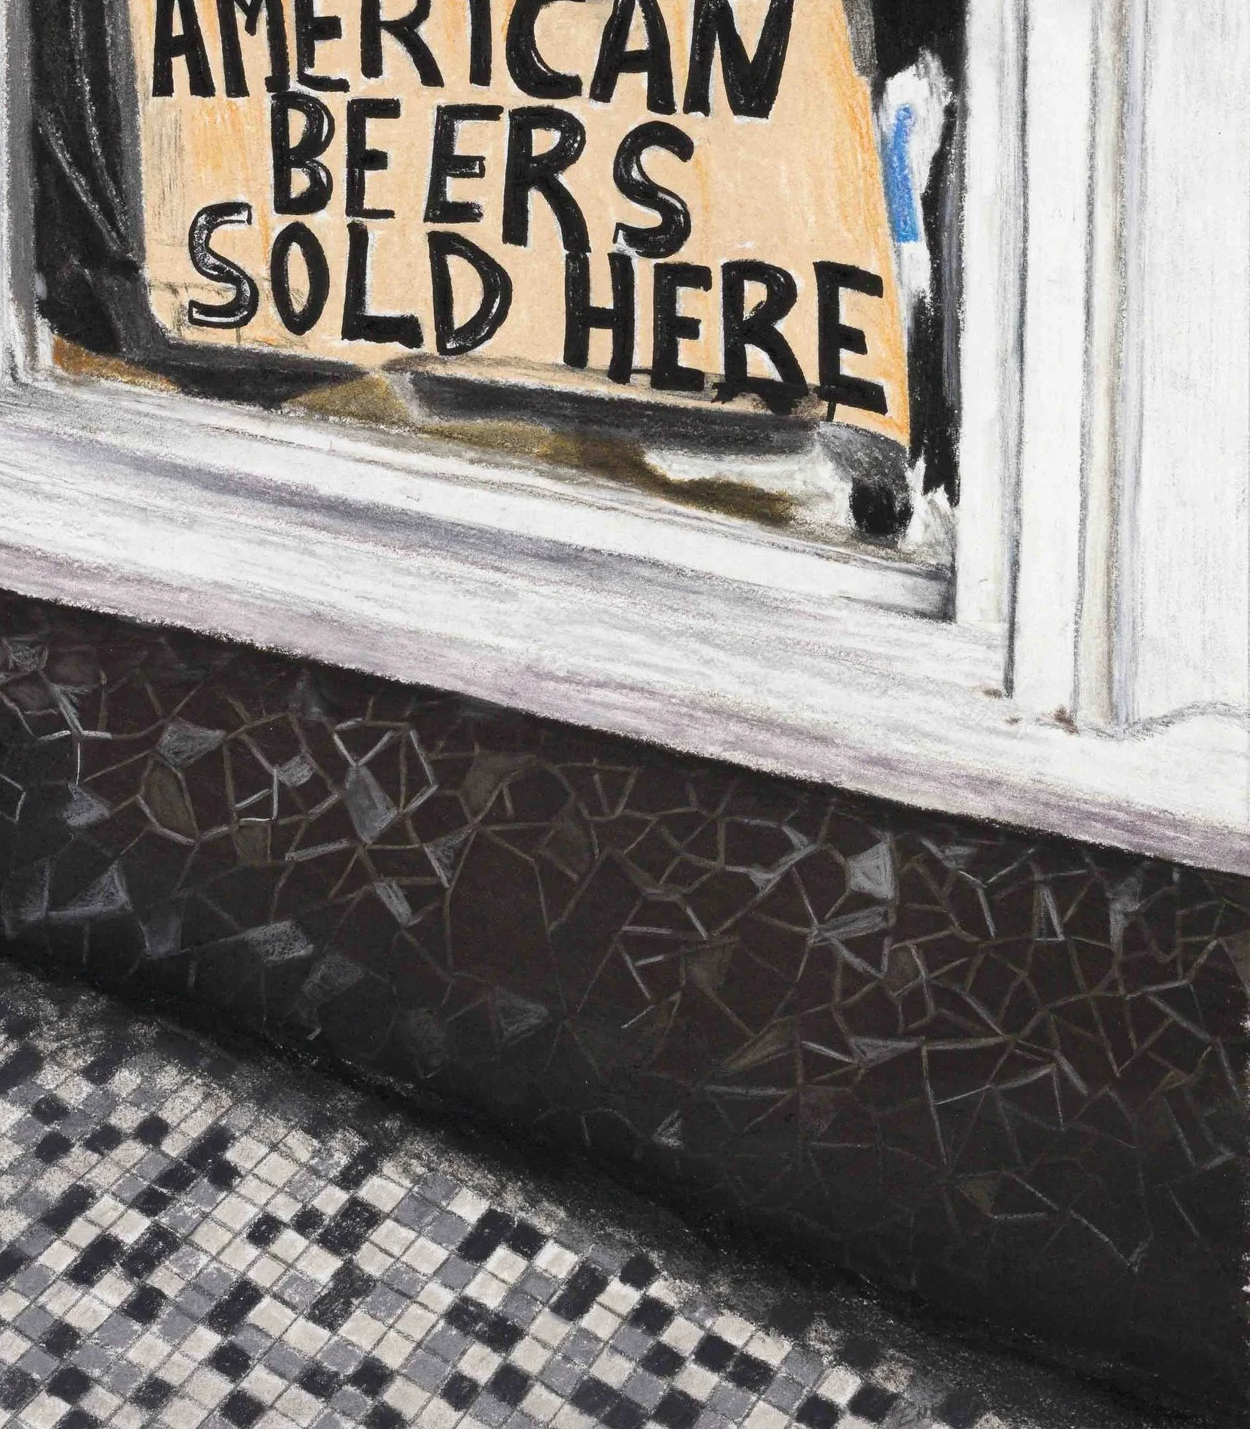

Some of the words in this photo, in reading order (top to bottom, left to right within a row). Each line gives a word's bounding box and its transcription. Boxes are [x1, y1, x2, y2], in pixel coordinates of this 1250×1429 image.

[271, 90, 695, 259] BEERS
[188, 200, 513, 357] SOLD
[563, 249, 890, 417] HERE
